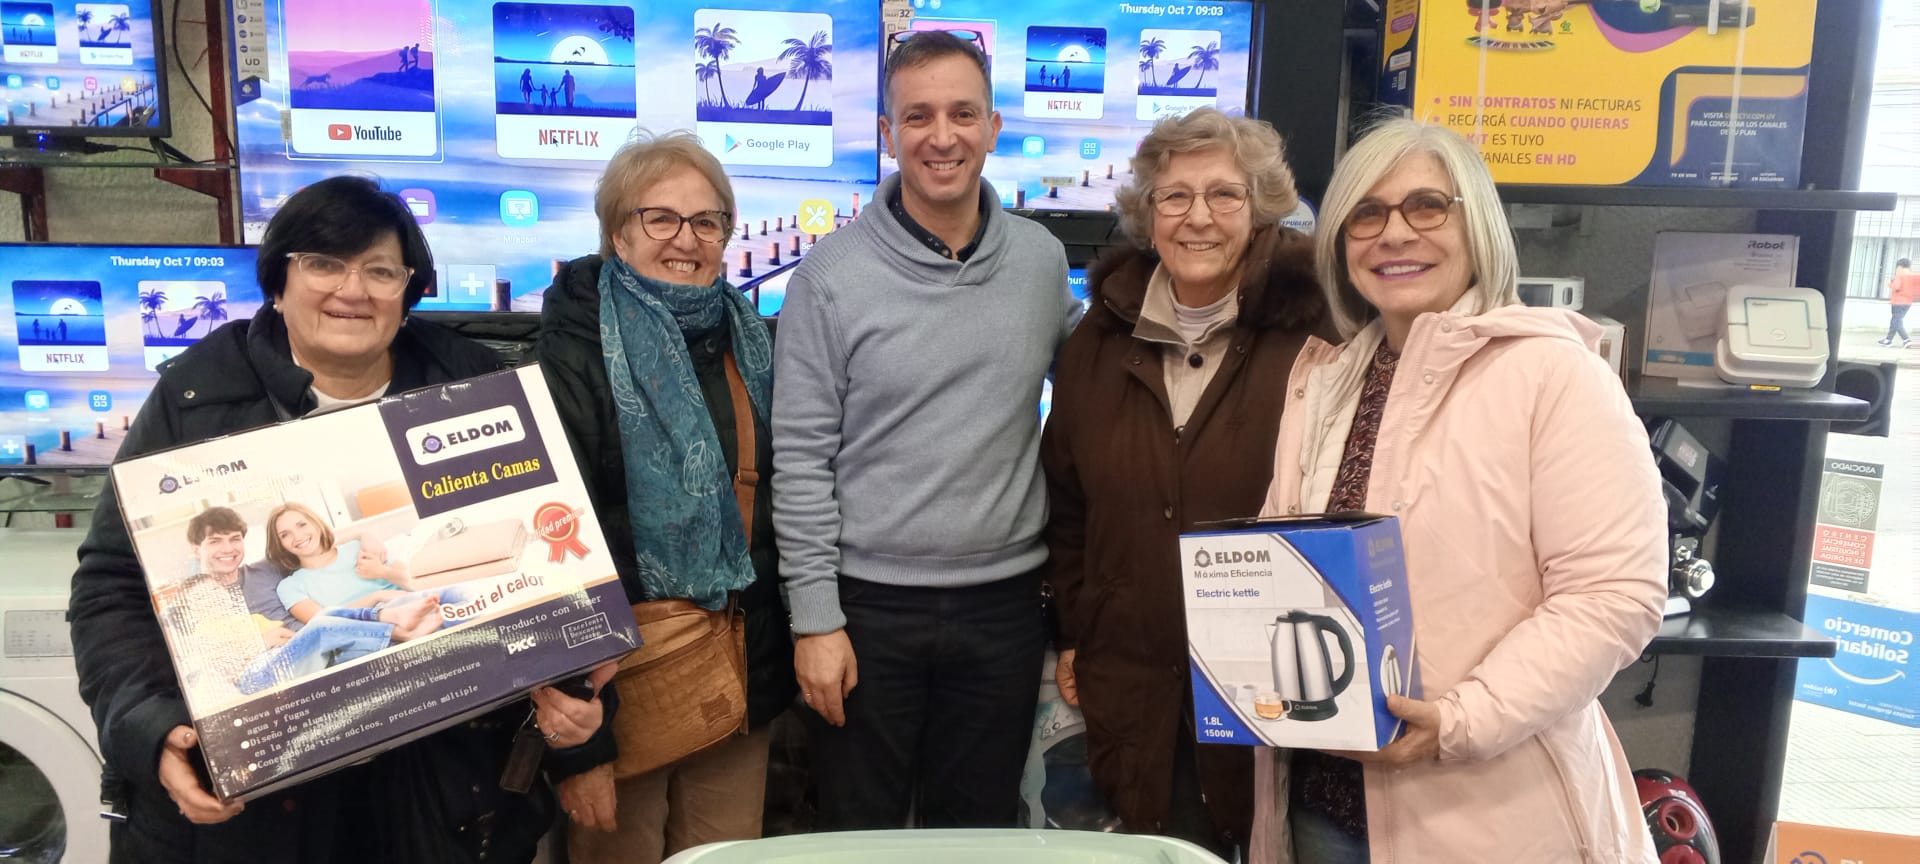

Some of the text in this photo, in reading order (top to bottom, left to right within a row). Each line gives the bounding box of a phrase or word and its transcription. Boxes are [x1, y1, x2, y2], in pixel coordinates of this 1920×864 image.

[1120, 3, 1224, 16] Thursday Oct 7 09:03
[1047, 100, 1082, 112] NETFLIX
[1449, 95, 1641, 112] SIN CONTRATOS NI FACTURAS
[1510, 116, 1566, 128] CUANDO
[1570, 117, 1630, 131] QUIERAS
[354, 126, 402, 142] YouTube
[539, 129, 600, 148] NETFLIX
[1492, 134, 1507, 145] ES
[1512, 134, 1545, 146] TUYO
[746, 138, 811, 152] Google Play
[1479, 152, 1577, 166] ANALES EN HD
[110, 256, 225, 268] Thursday Oct 7 09:03
[46, 353, 85, 365] NETFLIX
[446, 419, 513, 446] ELDOM
[421, 458, 541, 499] Calienta Camas
[1214, 550, 1272, 564] ELDOM
[1230, 568, 1273, 578] Eficiencia
[1196, 587, 1260, 598] Electric kettle
[442, 595, 487, 621] Senti
[490, 584, 504, 603] el
[499, 614, 548, 635] Producto
[552, 606, 570, 618] con
[507, 636, 537, 655] PICC
[242, 710, 271, 725] Nueva
[274, 690, 327, 714] generación
[330, 685, 341, 694] de
[345, 667, 391, 689] seguridad
[403, 654, 433, 670] prueba
[249, 729, 283, 747] Diseño
[286, 724, 298, 734] de
[429, 661, 481, 684] temperatura
[247, 722, 269, 736] agua
[283, 708, 310, 723] fugas
[304, 742, 316, 753] de
[319, 733, 341, 746] tres
[388, 698, 438, 723] protección
[440, 684, 479, 704] múltiple
[1203, 716, 1223, 726] 1.8L
[1204, 729, 1234, 738] 1500W
[254, 749, 266, 758] en
[270, 742, 282, 752] la
